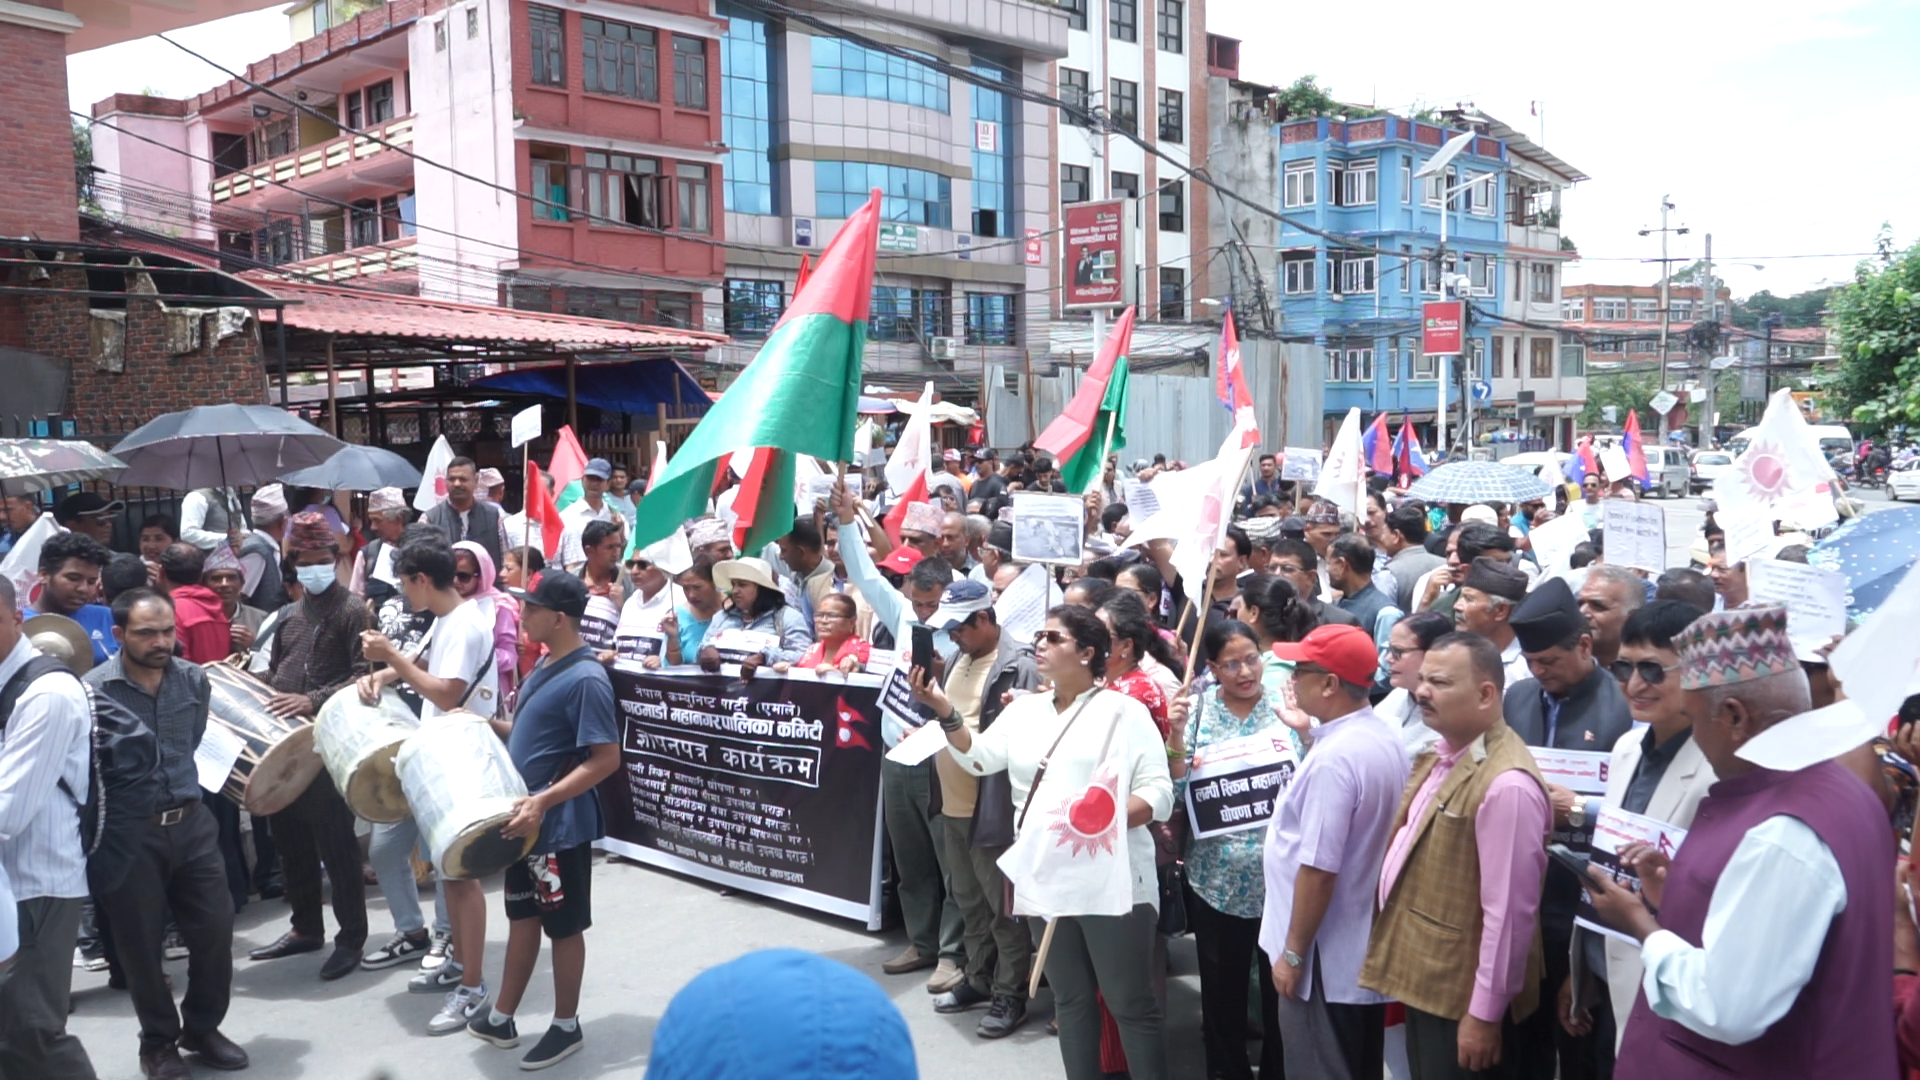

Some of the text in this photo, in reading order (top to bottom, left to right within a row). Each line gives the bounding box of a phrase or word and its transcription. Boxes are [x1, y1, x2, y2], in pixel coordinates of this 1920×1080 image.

[634, 684, 801, 716] नेपाल कम्युनिष्ट पार्टी (एमाले)
[670, 707, 774, 736] महानगरपालिका
[777, 718, 824, 741] कमिटी
[720, 746, 814, 779] कार्यक्रम
[708, 779, 736, 794] घोषणा
[1194, 781, 1220, 802] लम्पी
[1220, 778, 1250, 797] स्किन
[724, 796, 756, 810] उपलब्ध
[1220, 805, 1252, 822] घोषणा
[1252, 800, 1270, 815] गर
[732, 810, 762, 825] उपलब्ध
